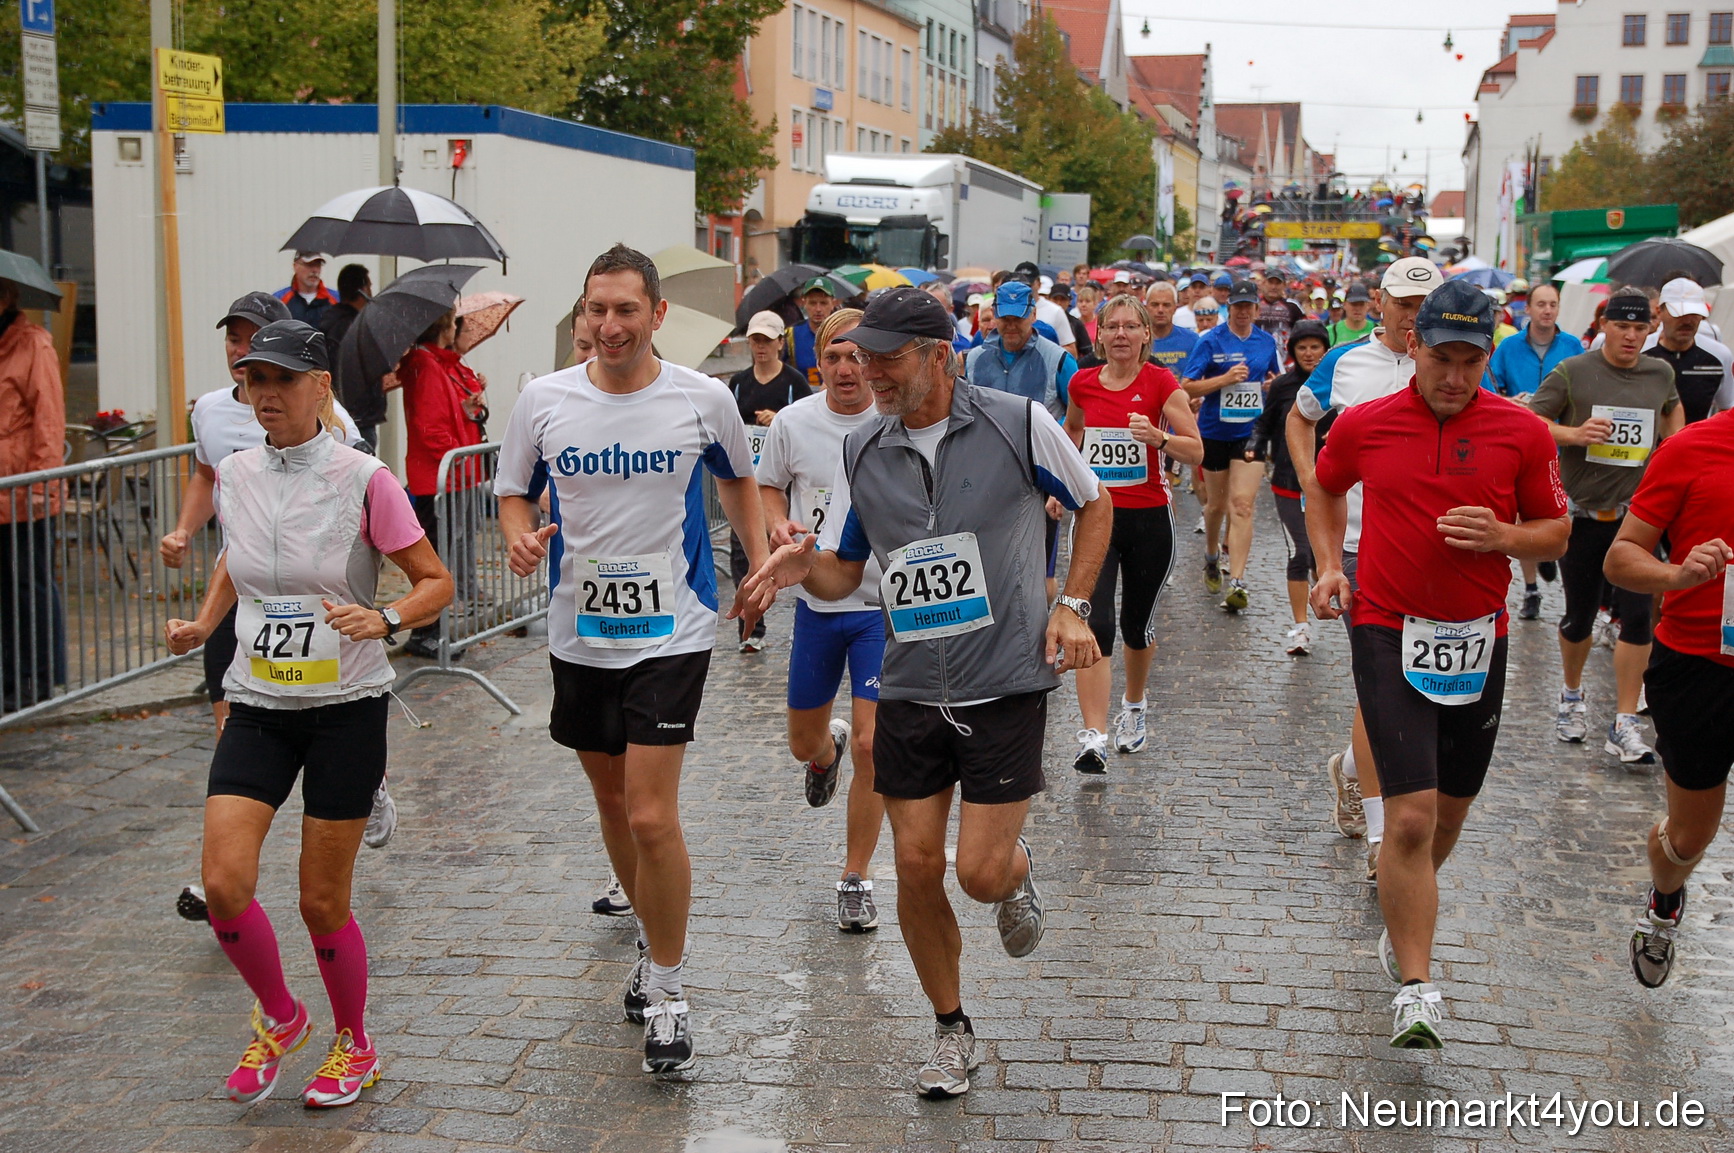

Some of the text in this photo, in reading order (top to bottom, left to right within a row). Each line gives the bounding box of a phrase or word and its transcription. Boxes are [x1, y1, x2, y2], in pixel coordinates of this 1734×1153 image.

[169, 55, 205, 71] Kinder-
[163, 72, 211, 94] betreuung
[838, 196, 898, 209] BOCK
[1302, 226, 1341, 236] START
[1442, 312, 1479, 324] FEUERWEHR
[1225, 393, 1259, 407] 2422
[556, 442, 682, 480] Gothaer
[1089, 443, 1141, 465] 2993
[1610, 448, 1629, 459] Jörg
[906, 543, 945, 559] BOCK
[598, 562, 639, 572] BOCK
[890, 560, 976, 606] 2432
[582, 579, 661, 615] 2431
[263, 602, 302, 612] BOCK
[600, 621, 649, 635] Gerhard
[1435, 625, 1472, 637] BOCK
[253, 622, 315, 658] 427
[269, 665, 303, 681] Linda
[1422, 677, 1472, 692] Christian
